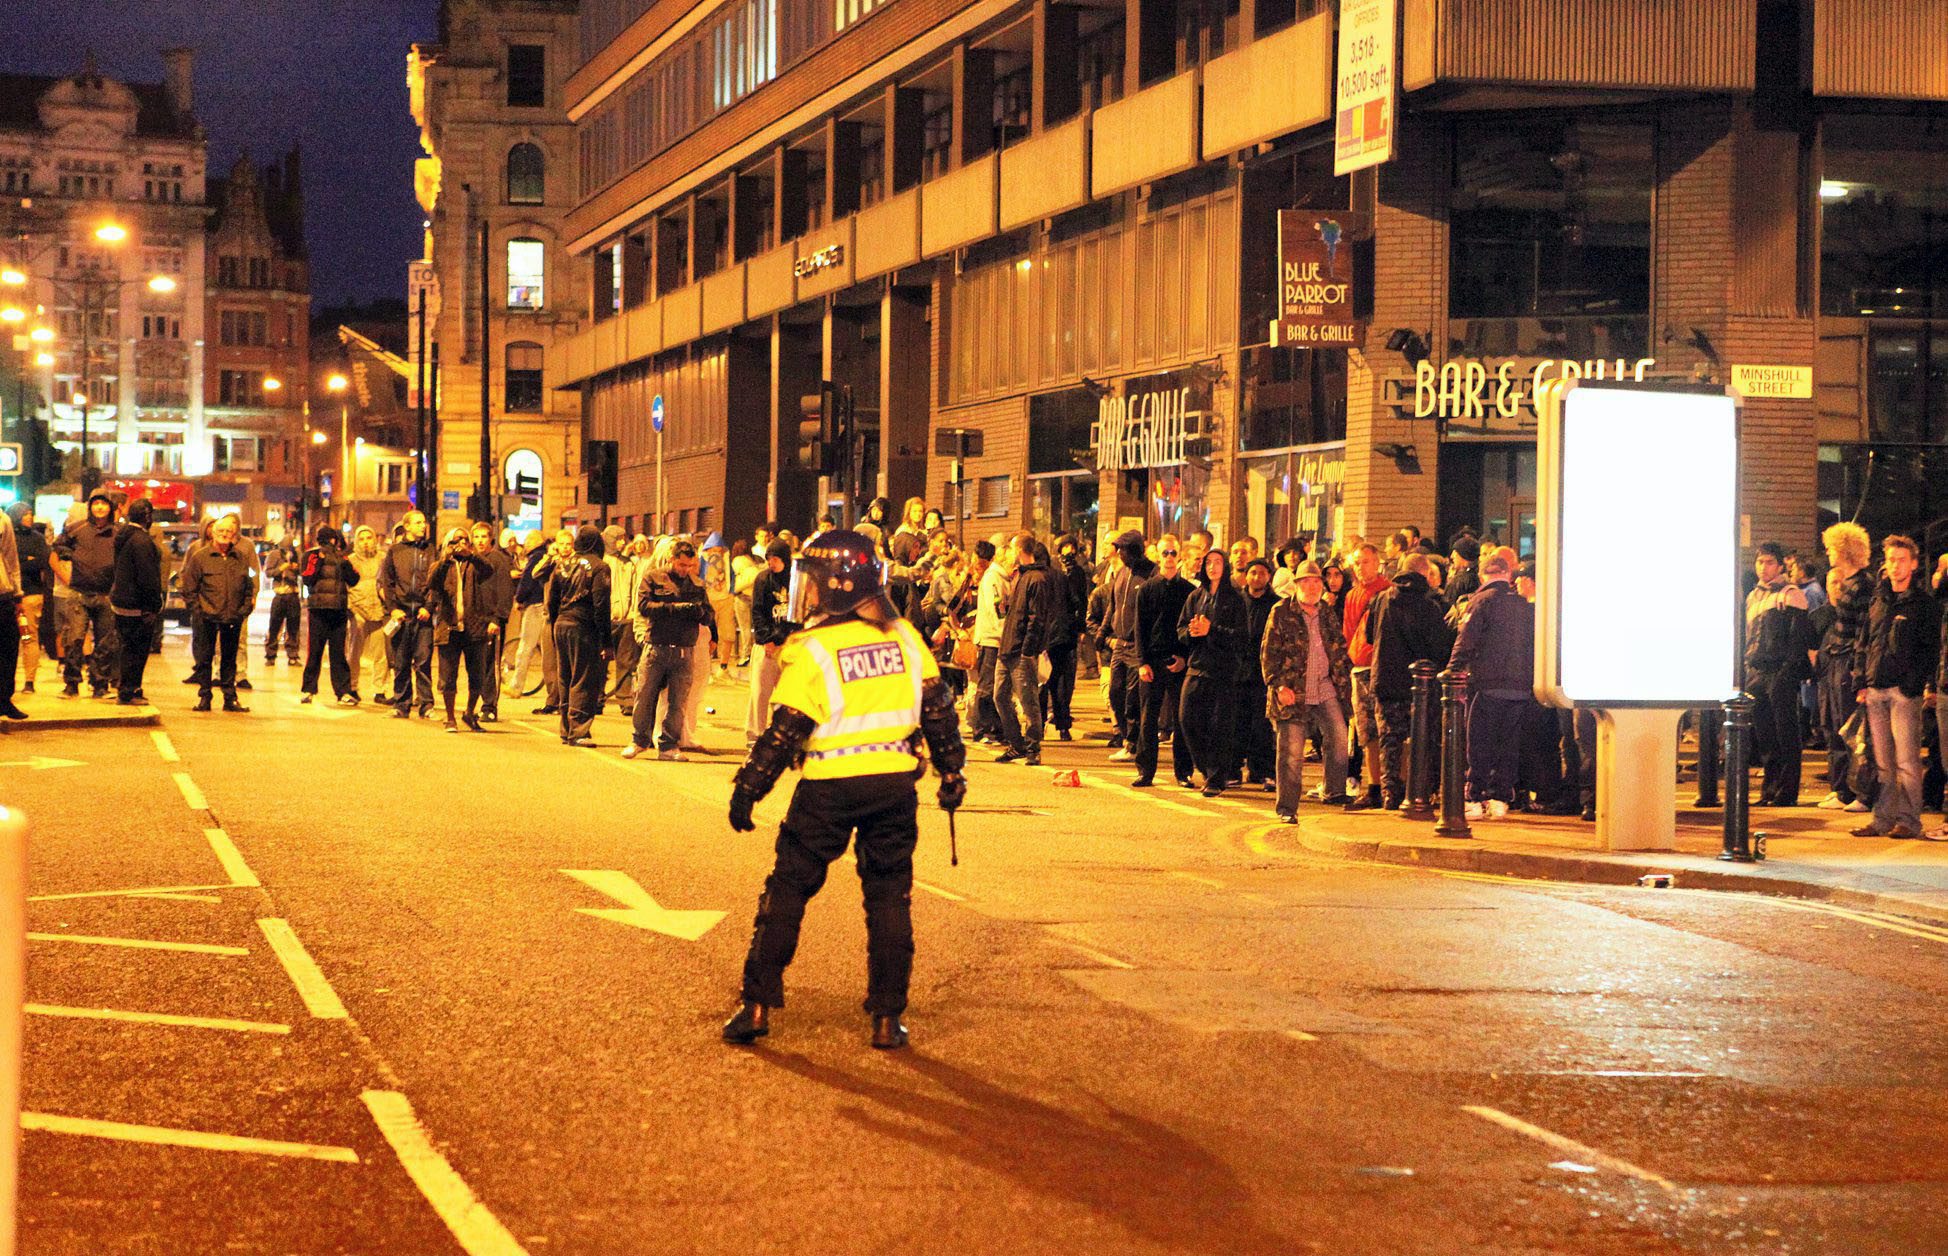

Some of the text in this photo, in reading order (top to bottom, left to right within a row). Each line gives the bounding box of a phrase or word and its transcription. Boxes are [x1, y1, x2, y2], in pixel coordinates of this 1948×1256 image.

[1350, 35, 1375, 65] 3,518
[1340, 71, 1367, 99] 10,500
[414, 268, 434, 282] TO
[1285, 262, 1323, 282] BLUE
[410, 284, 435, 296] LT
[1285, 284, 1348, 304] PARROT
[1286, 305, 1298, 315] BAR
[1304, 305, 1323, 315] GRILLE
[1287, 325, 1354, 341] BAR & GRILLE
[1740, 368, 1803, 383] MINSHULL
[1415, 360, 1486, 418] BAR
[1497, 361, 1524, 418] &
[1748, 381, 1794, 395] STREET
[1097, 387, 1190, 470] BAR & GRILLE
[1298, 454, 1317, 485] Live
[840, 647, 904, 683] POLICE
